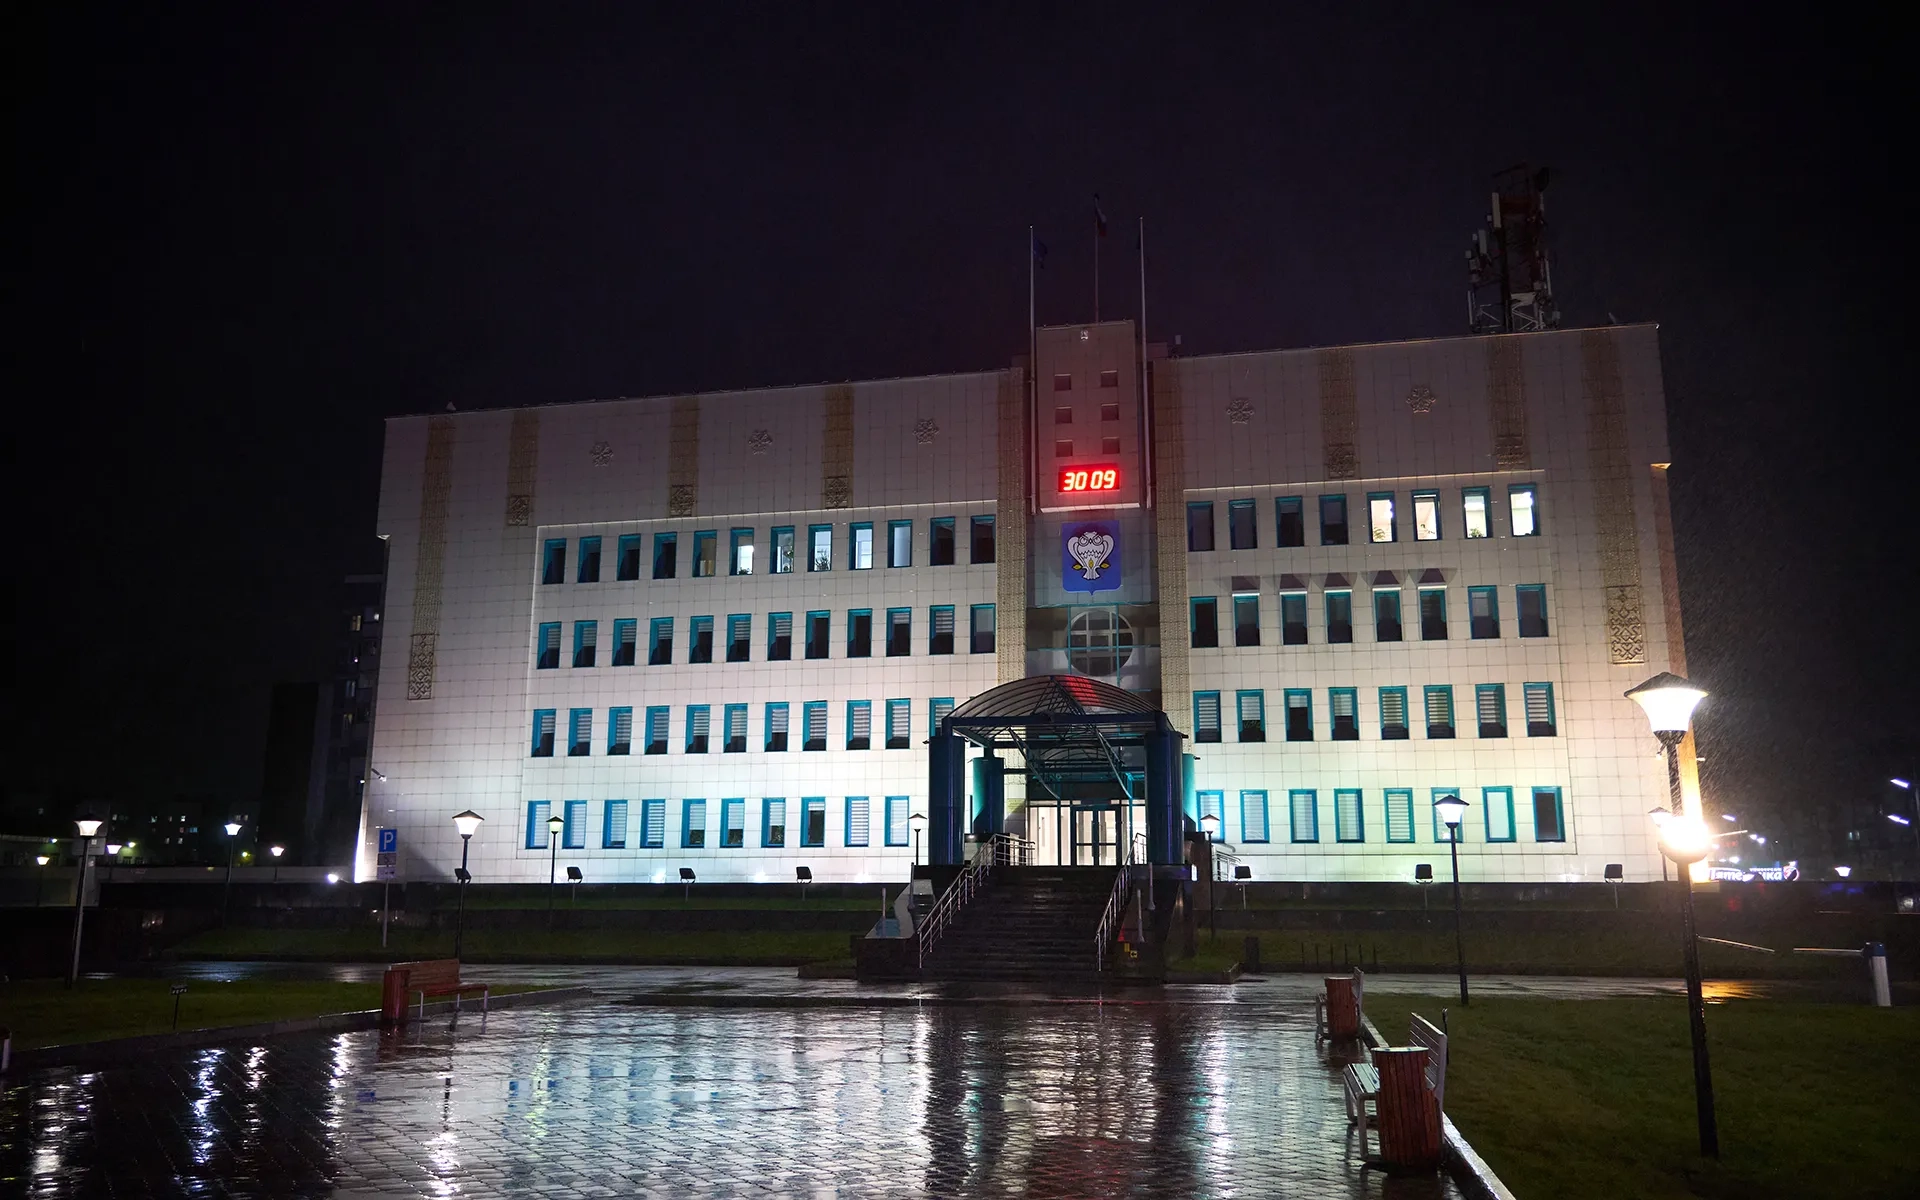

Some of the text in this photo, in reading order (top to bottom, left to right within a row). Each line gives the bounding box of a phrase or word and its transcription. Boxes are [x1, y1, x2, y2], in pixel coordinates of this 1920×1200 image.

[1063, 470, 1116, 491] 30 09
[383, 831, 394, 850] P
